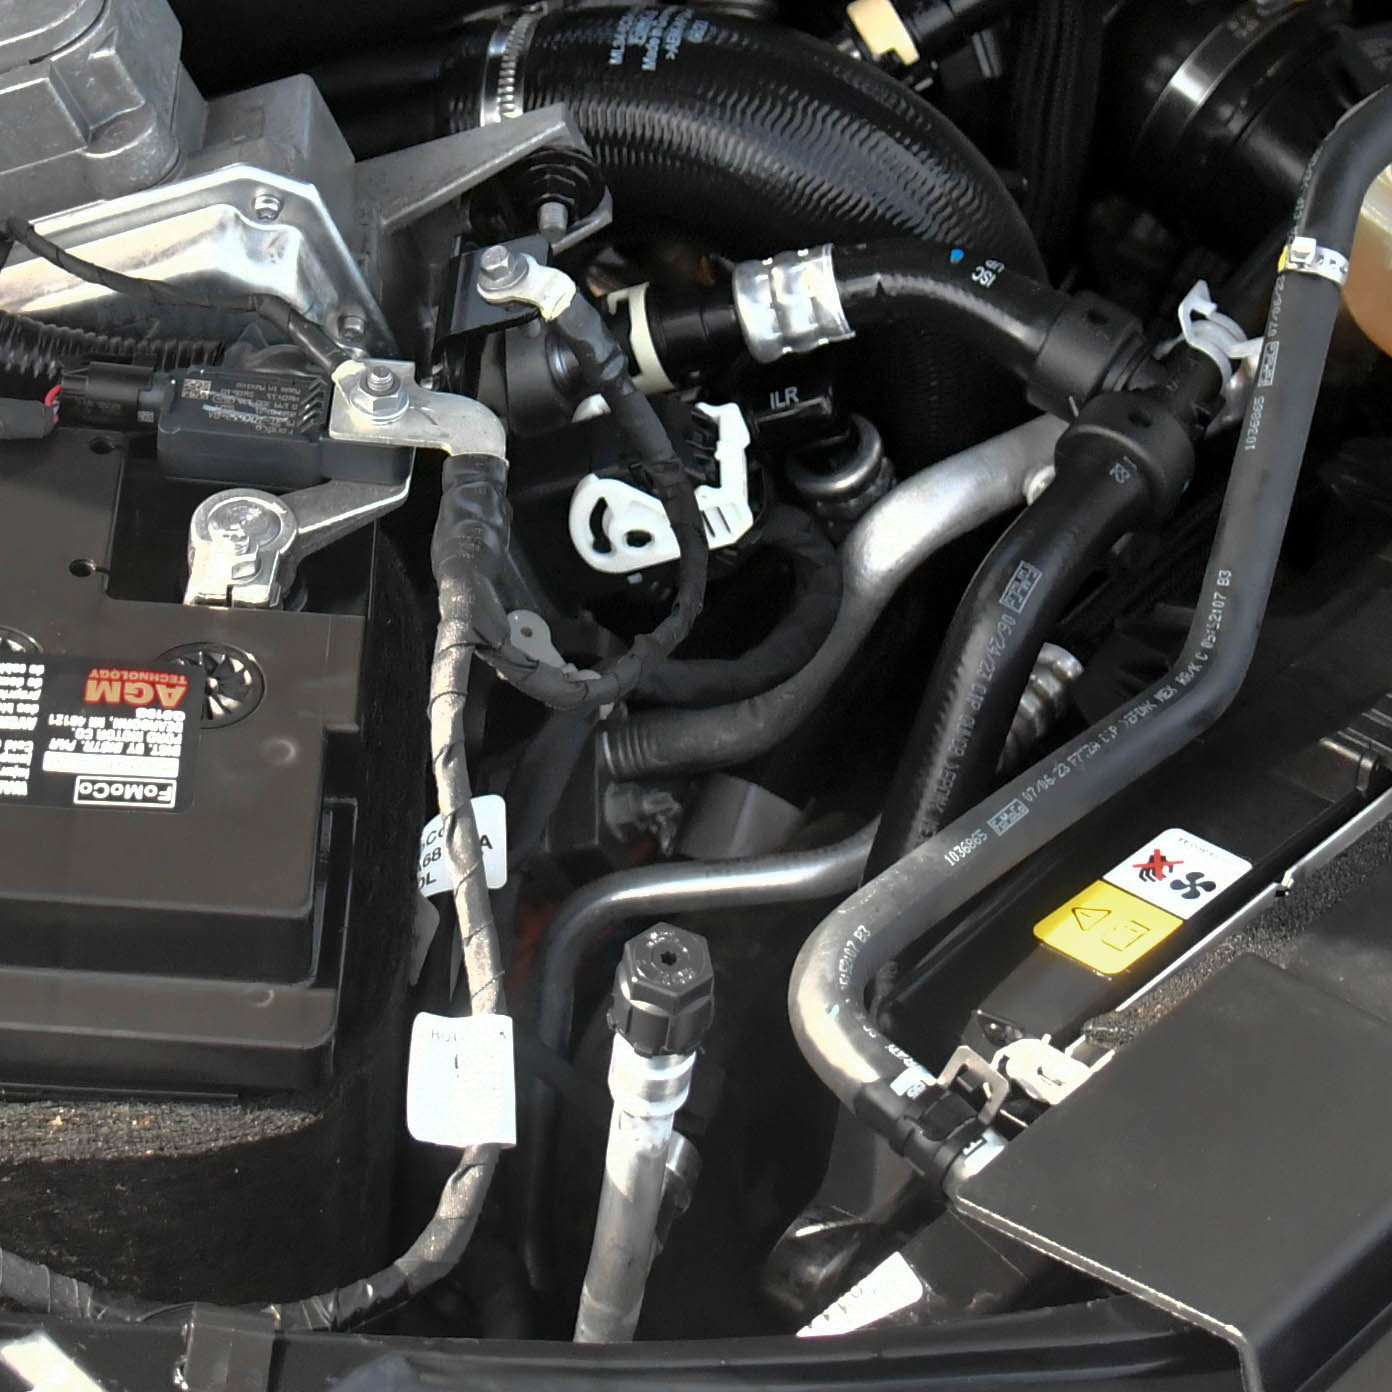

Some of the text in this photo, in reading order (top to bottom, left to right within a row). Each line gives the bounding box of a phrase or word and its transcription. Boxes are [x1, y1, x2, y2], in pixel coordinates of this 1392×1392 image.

[971, 266, 997, 288] ISC
[90, 669, 187, 683] TECHNOLOGY
[85, 681, 186, 707] AGM
[79, 783, 173, 801] FoMoCo
